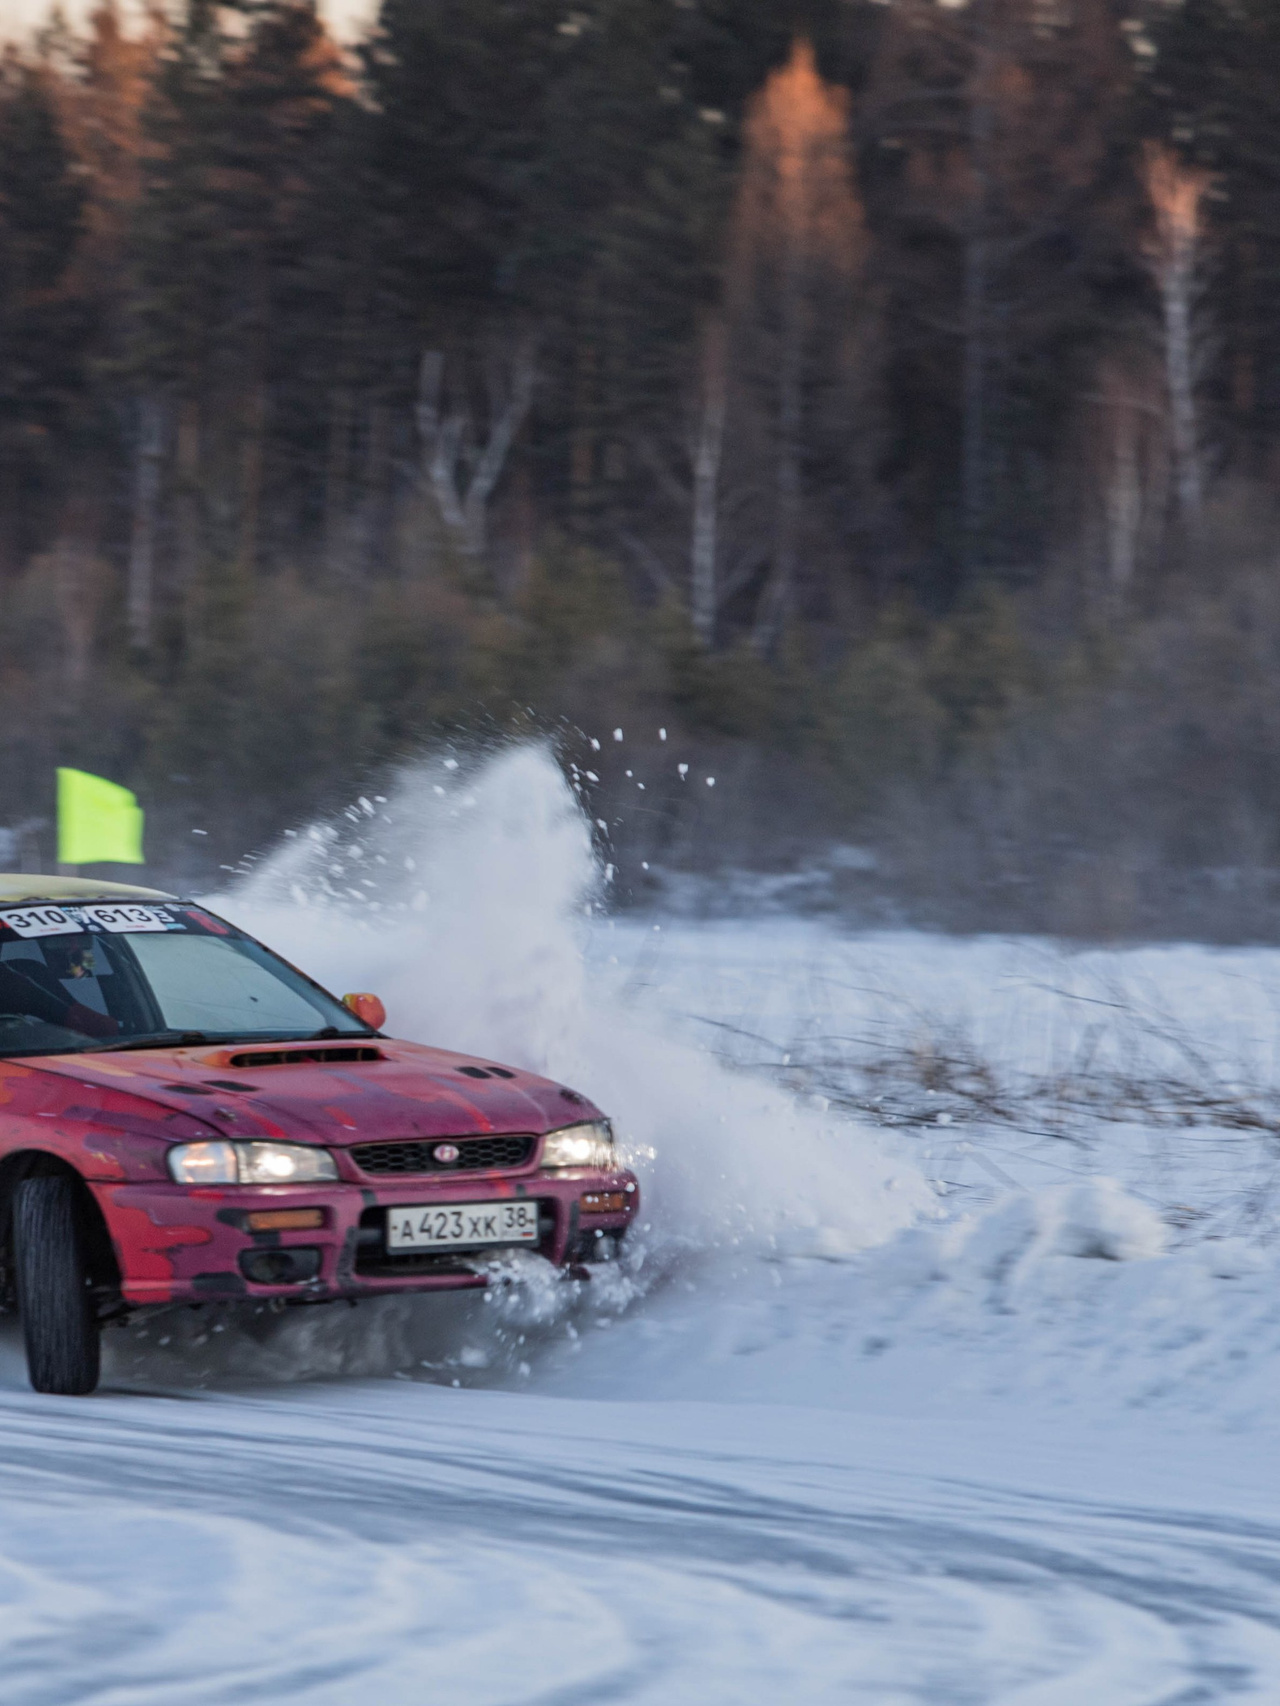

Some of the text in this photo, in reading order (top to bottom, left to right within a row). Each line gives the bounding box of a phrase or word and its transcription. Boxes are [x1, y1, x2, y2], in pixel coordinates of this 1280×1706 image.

[6, 910, 67, 928] 310
[94, 908, 152, 923] 613
[504, 1206, 528, 1228] 38
